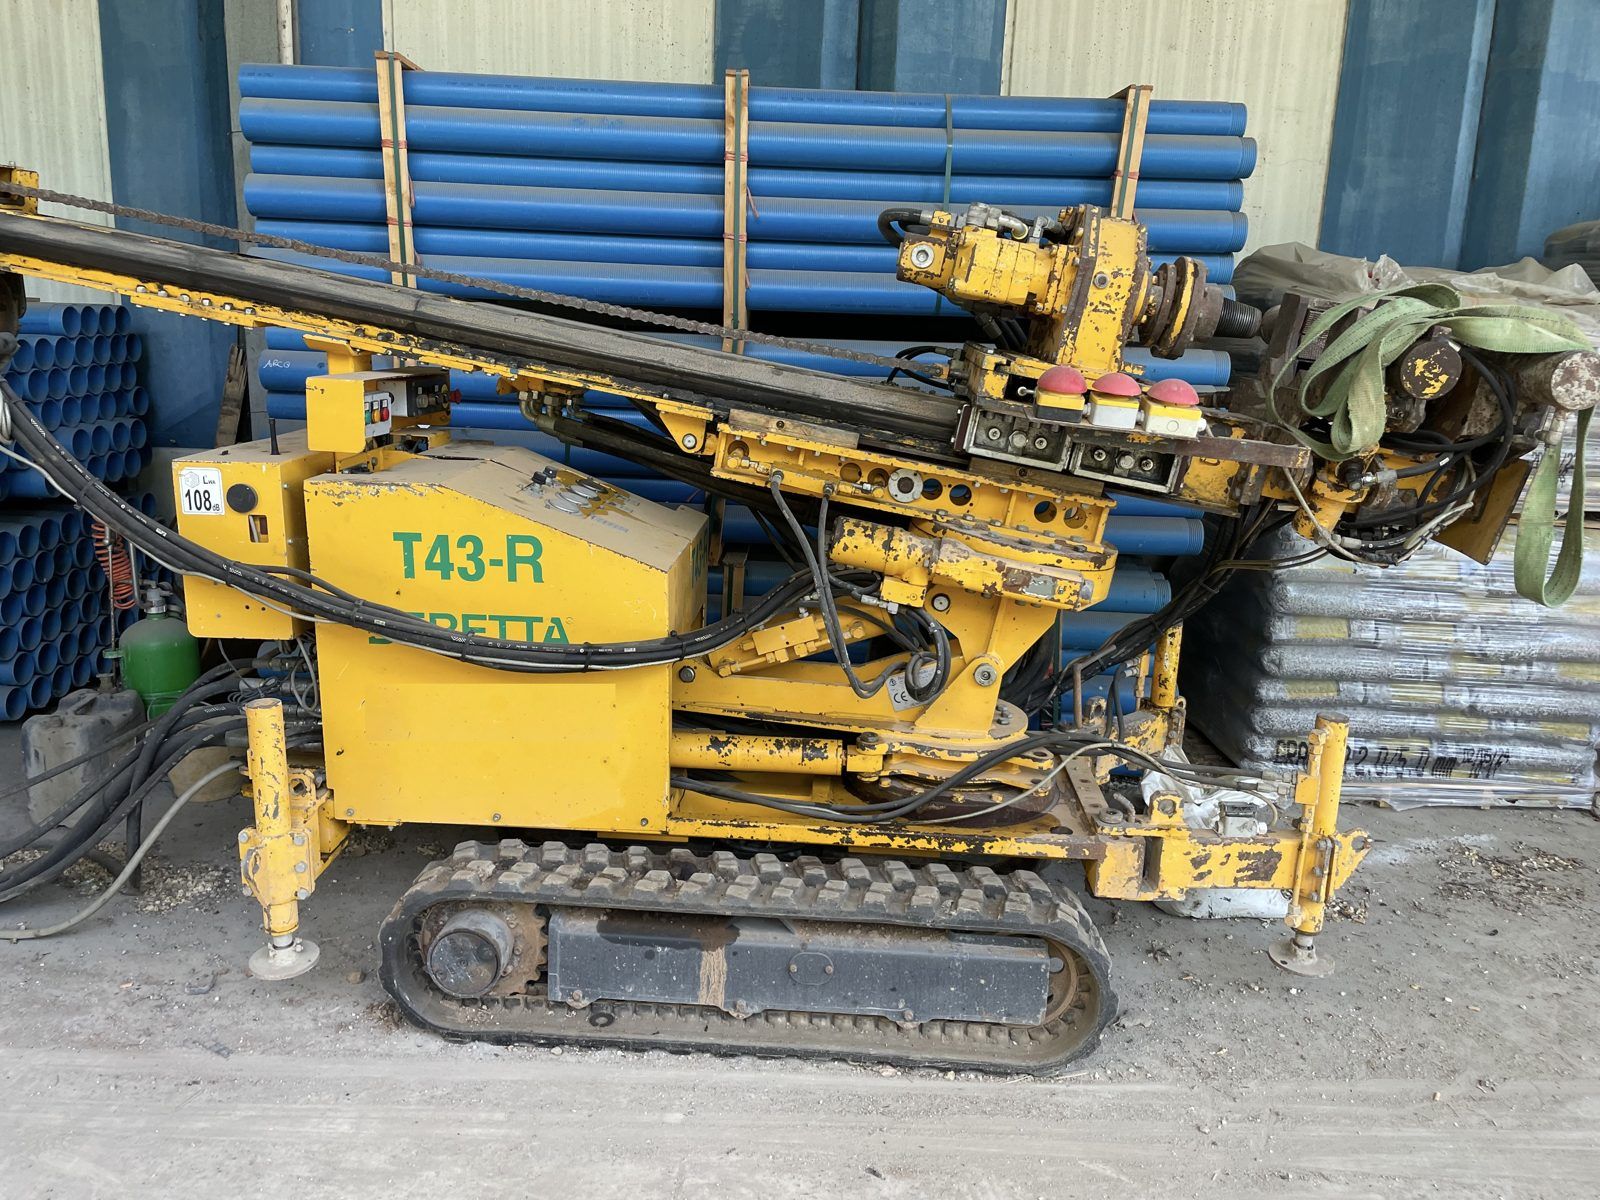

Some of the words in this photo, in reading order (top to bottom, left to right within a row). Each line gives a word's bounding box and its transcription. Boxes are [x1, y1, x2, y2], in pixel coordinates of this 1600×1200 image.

[185, 489, 212, 511] 108
[393, 532, 544, 583] T43-R
[369, 613, 568, 645] RETTA
